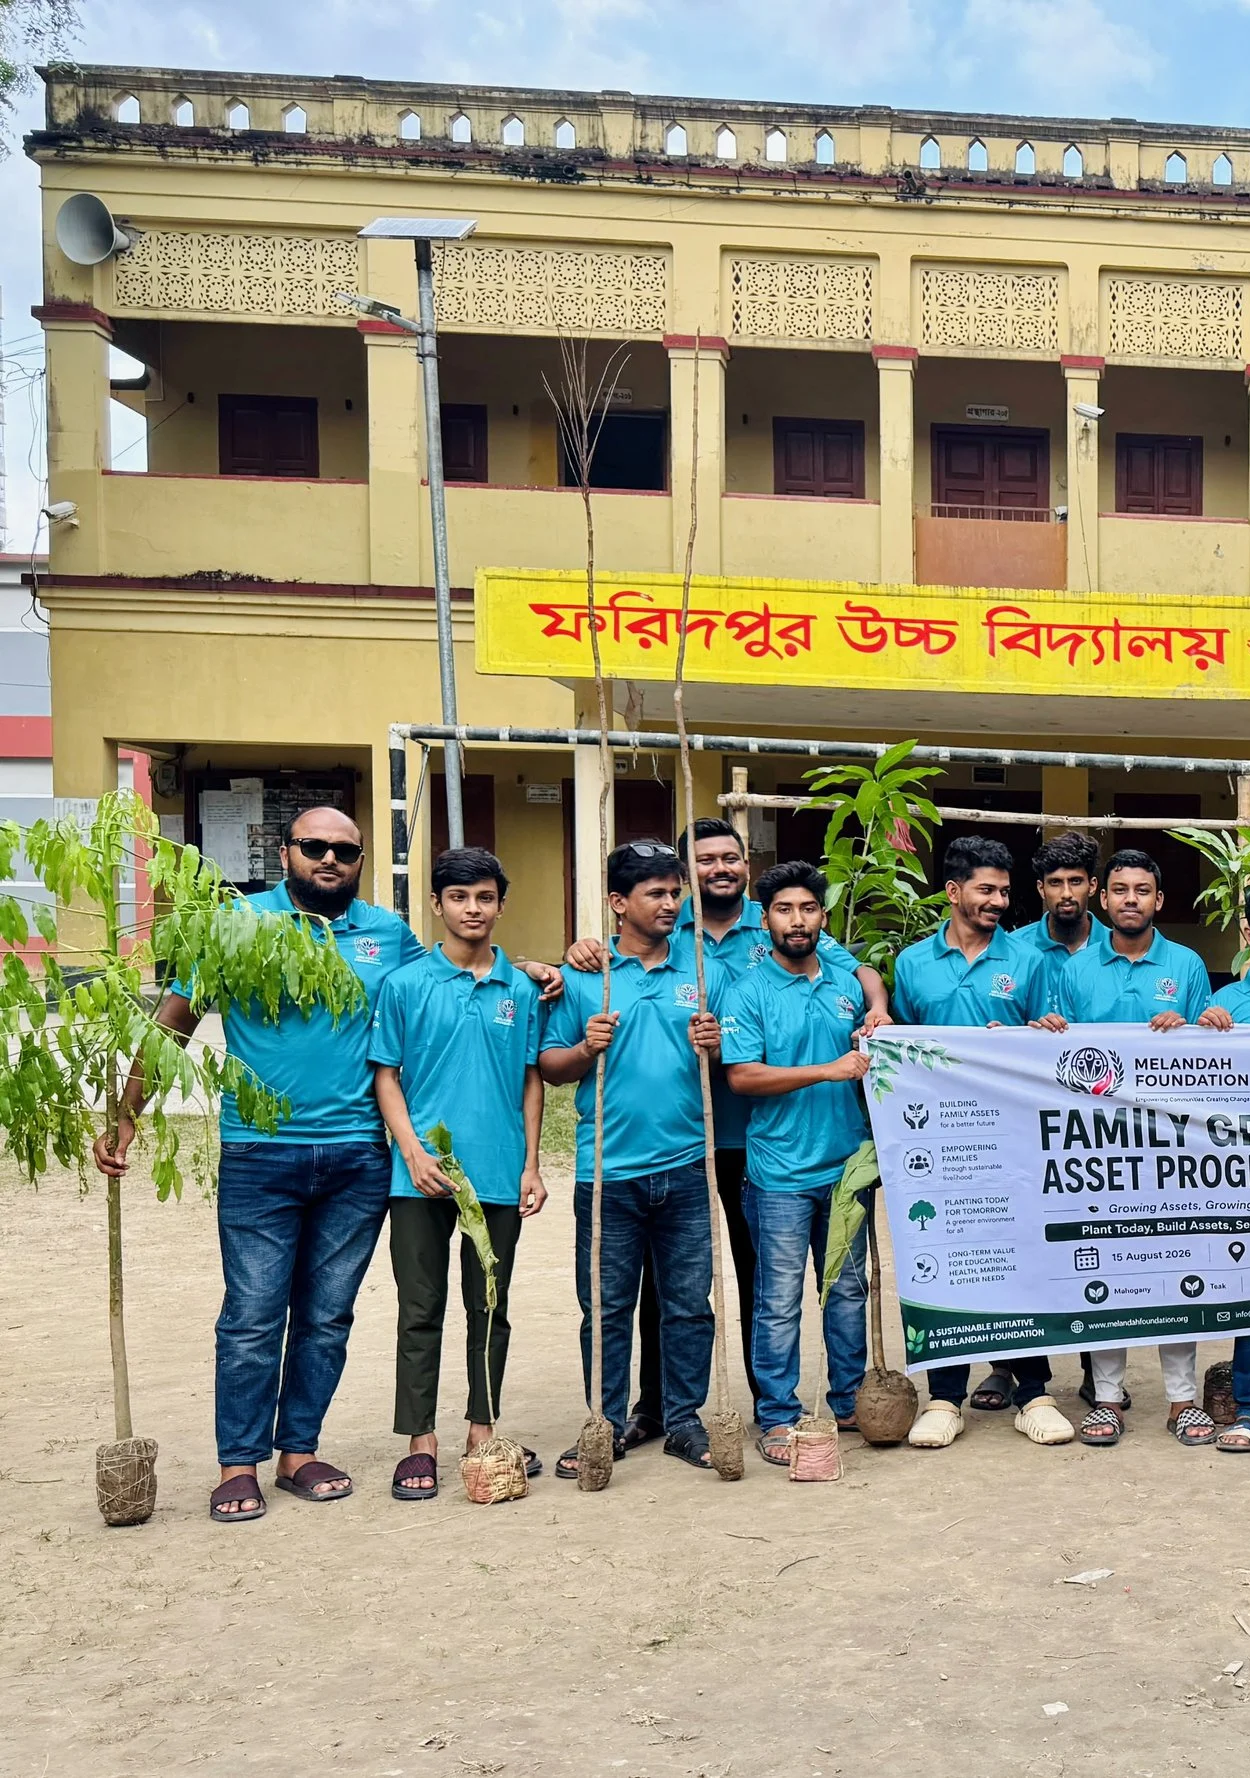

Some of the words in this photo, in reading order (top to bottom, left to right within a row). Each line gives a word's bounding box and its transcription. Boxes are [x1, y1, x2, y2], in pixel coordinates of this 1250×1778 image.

[528, 590, 818, 661] ফরিদপুর
[834, 599, 960, 655] উচ্চ
[980, 605, 1230, 671] বিদ্যালয়
[1135, 1058, 1232, 1070] MELANDAH
[1135, 1074, 1249, 1087] FOUNDATION
[939, 1100, 978, 1108] BUILDING
[940, 1110, 967, 1118] FAMILY
[970, 1109, 1000, 1117] ASSETS
[1039, 1107, 1190, 1151] FAMILY
[941, 1143, 998, 1153] EMPOWERING
[942, 1154, 978, 1163] FAMILIES
[942, 1165, 967, 1173] through
[968, 1163, 1003, 1171] sustainable
[1042, 1156, 1144, 1194] ASSET
[944, 1198, 983, 1206] PLANTING
[985, 1196, 1010, 1204] TODAY
[945, 1208, 961, 1216] FOR
[963, 1206, 1009, 1215] TOMORROW
[1109, 1202, 1157, 1215] Growing
[1159, 1201, 1201, 1212] Assets,
[977, 1216, 1015, 1224] environment
[1081, 1224, 1112, 1236] Plant
[1114, 1223, 1154, 1235] Today,
[1156, 1220, 1187, 1232] Build
[1189, 1220, 1233, 1232] Assets,
[948, 1249, 991, 1259] LONG-TERM
[993, 1247, 1016, 1255] VALUE
[1112, 1252, 1123, 1262] 15
[1125, 1250, 1163, 1262] August
[1165, 1249, 1192, 1259] 2026
[948, 1260, 963, 1268] FOR
[965, 1257, 1009, 1266] EDUCATION,
[949, 1269, 978, 1277] HEALTH,
[979, 1265, 1017, 1274] MARRIAGE
[956, 1276, 980, 1285] OTHER
[981, 1275, 1005, 1283] NEEDS
[1210, 1282, 1227, 1290] Teak
[1114, 1286, 1152, 1296] Mahogany
[928, 1329, 935, 1338] A
[936, 1323, 991, 1337] SUSTAINABLE
[992, 1318, 1035, 1330] INITIATIVE
[1088, 1315, 1189, 1330] www.melandahfoundation.org
[929, 1340, 940, 1349] BY
[941, 1333, 989, 1347] MELANDAH
[990, 1328, 1045, 1342] FOUNDATION
